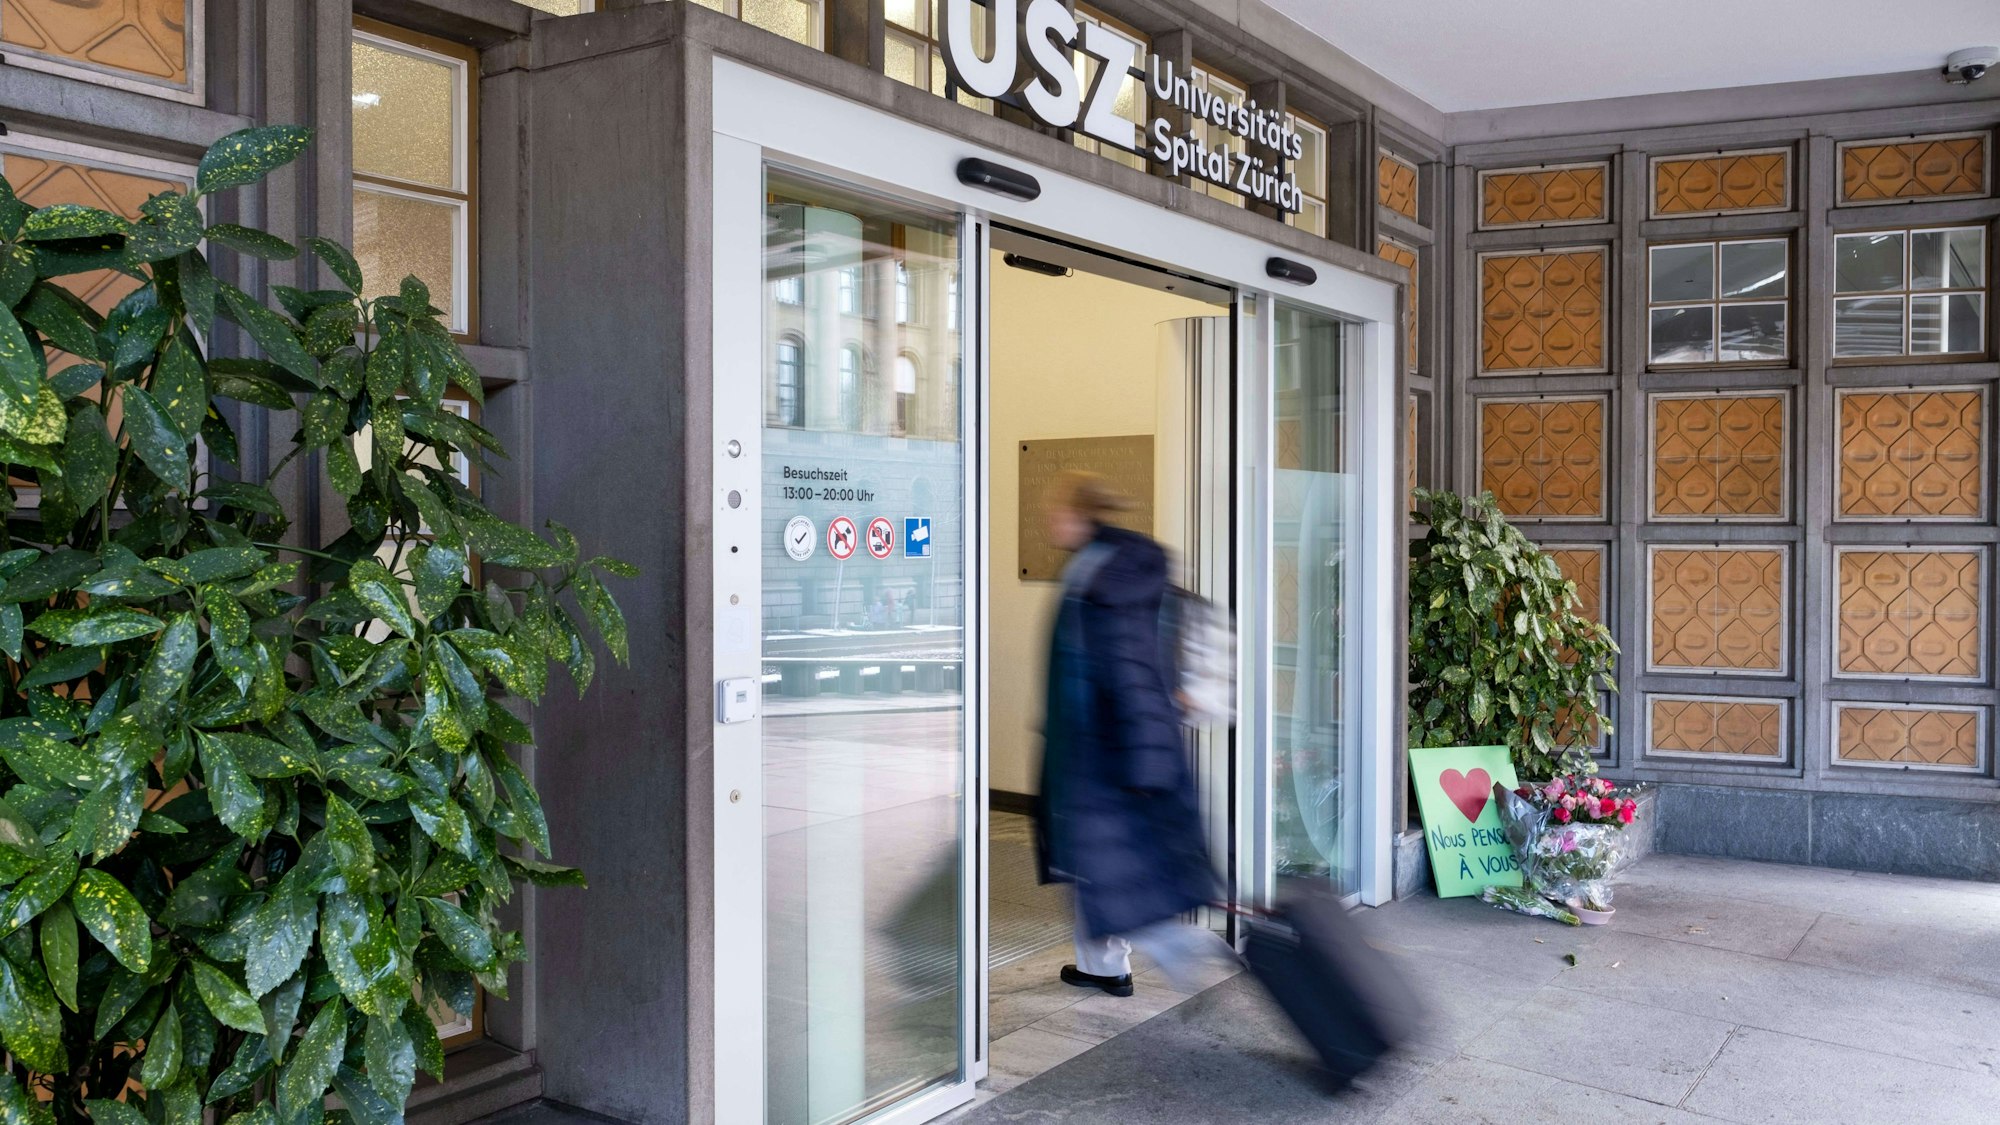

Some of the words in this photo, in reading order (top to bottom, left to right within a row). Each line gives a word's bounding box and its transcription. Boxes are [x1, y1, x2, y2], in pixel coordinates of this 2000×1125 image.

[946, 0, 1136, 150] USZ
[1153, 53, 1303, 160] Universitäts
[1153, 117, 1229, 185] Spital
[1236, 153, 1303, 213] Zürich
[783, 466, 848, 481] Besuchszeit
[857, 489, 875, 502] Uhr
[1459, 853, 1474, 880] À
[1478, 854, 1520, 876] VOUS
